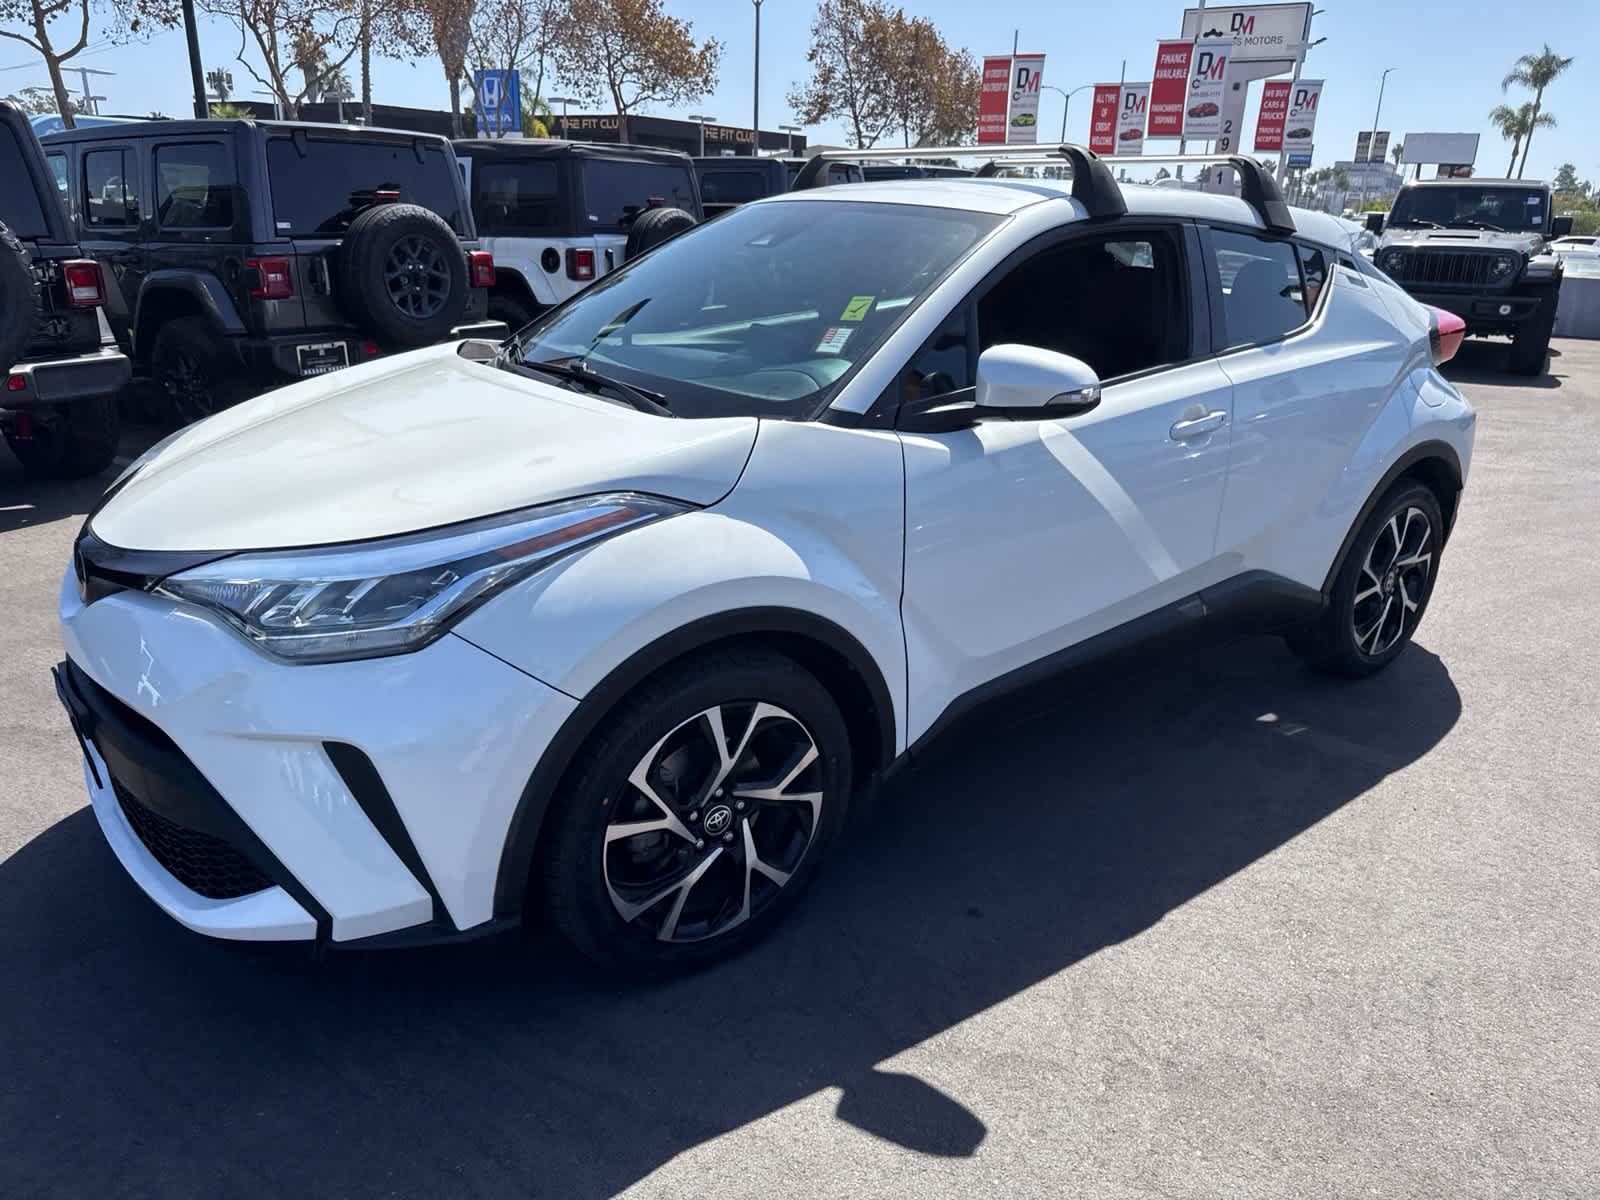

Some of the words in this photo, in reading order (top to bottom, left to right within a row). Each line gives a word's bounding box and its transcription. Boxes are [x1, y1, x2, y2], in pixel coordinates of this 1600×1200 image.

[1244, 35, 1283, 46] MOTORS
[1160, 53, 1187, 65] FINANCE
[1156, 68, 1188, 79] AVAILABLE
[1263, 100, 1280, 109] CARS
[1260, 111, 1285, 120] TRUCKS
[582, 118, 598, 129] FIT
[600, 118, 624, 129] CLU
[720, 128, 734, 140] FIT
